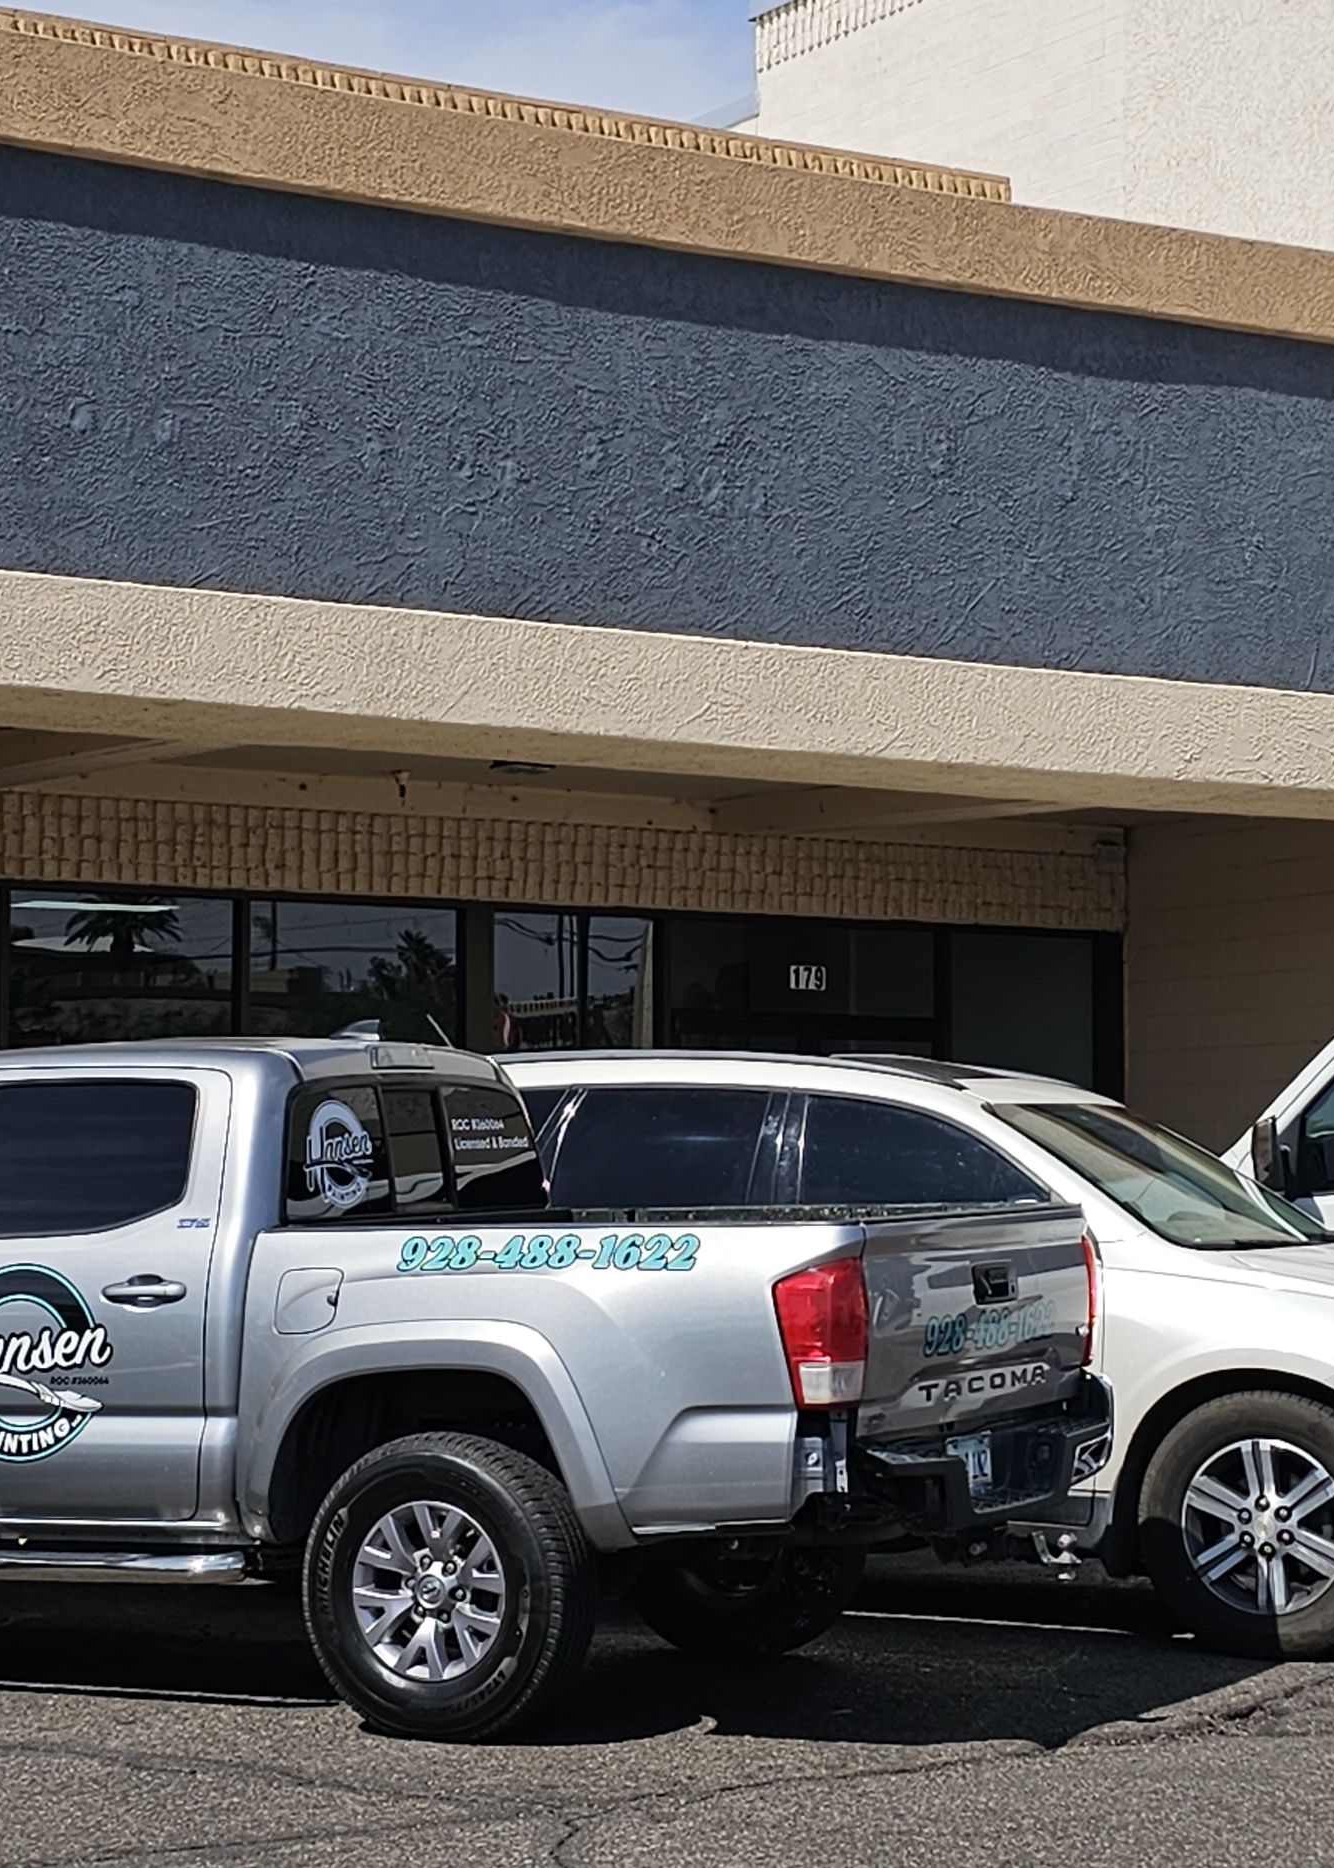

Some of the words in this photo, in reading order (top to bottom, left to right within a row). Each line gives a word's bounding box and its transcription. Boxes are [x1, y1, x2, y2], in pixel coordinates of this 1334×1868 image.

[792, 966, 824, 990] 179
[453, 1136, 491, 1151] Licensed
[498, 1135, 529, 1149] Bonded
[304, 1124, 372, 1202] Hansen
[397, 1233, 701, 1272] 928-488-1622
[923, 1301, 1057, 1358] 928-488-1622
[50, 1376, 69, 1386] ROC
[918, 1364, 1048, 1403] TACOMA
[317, 1513, 345, 1615] MICHELIN
